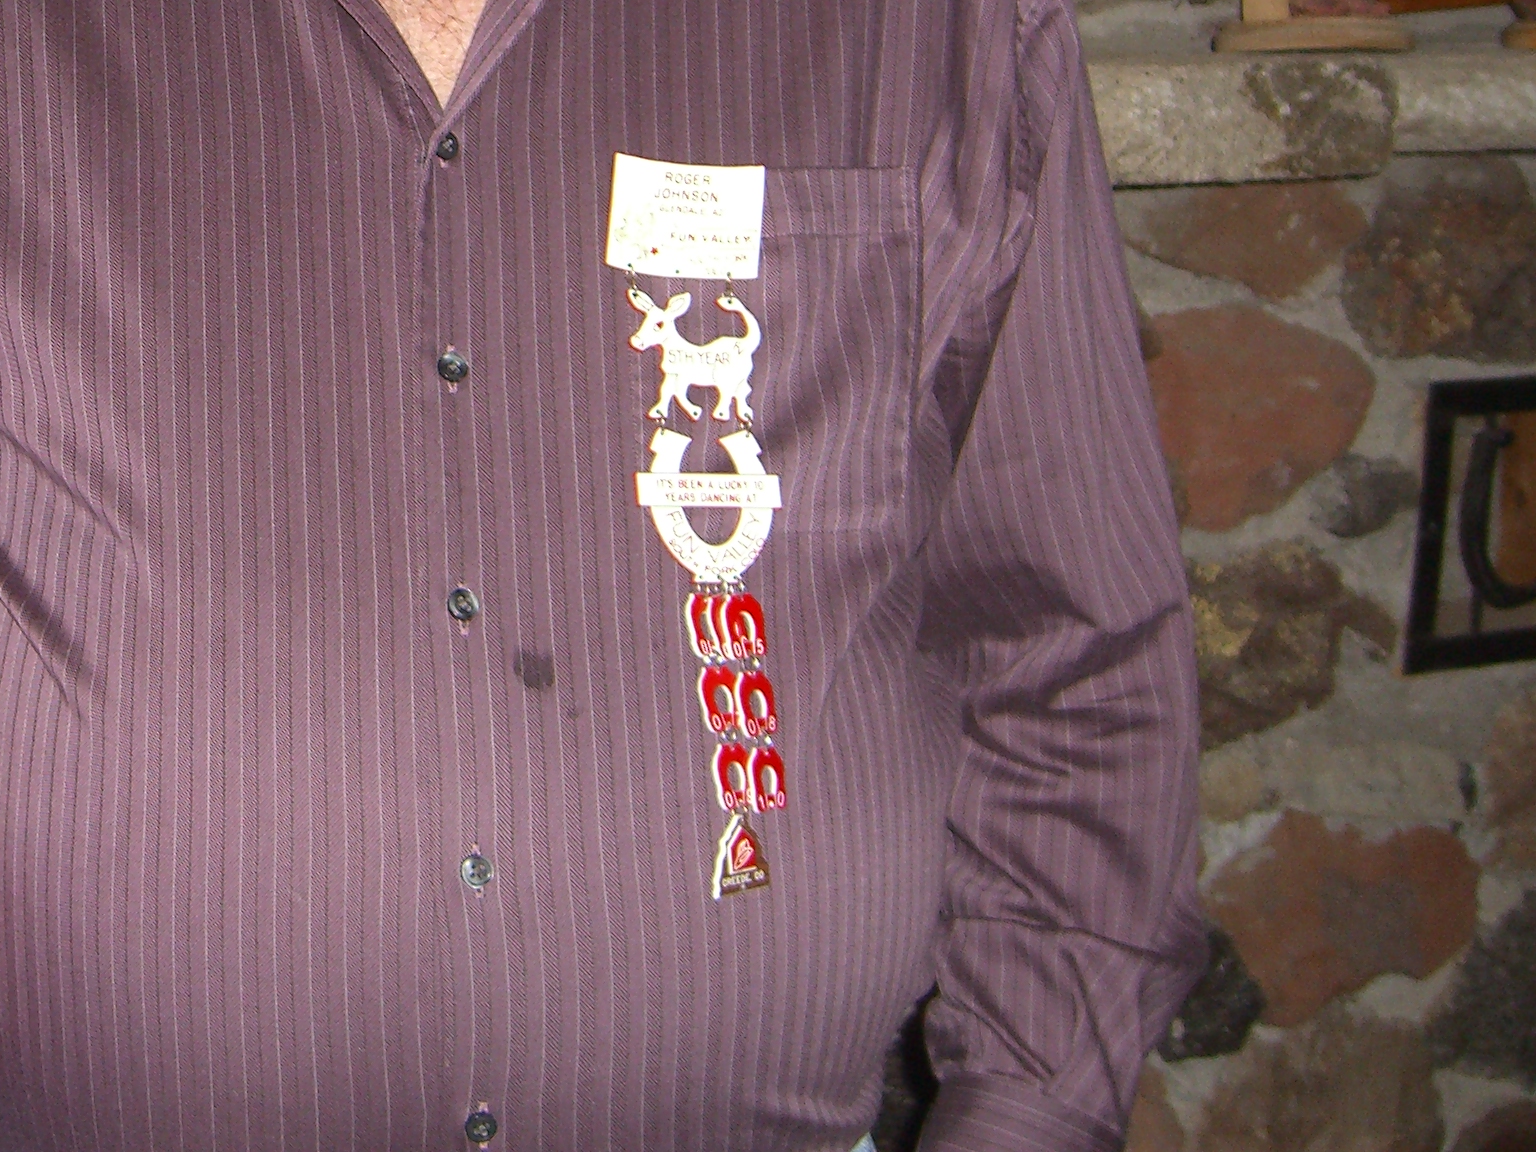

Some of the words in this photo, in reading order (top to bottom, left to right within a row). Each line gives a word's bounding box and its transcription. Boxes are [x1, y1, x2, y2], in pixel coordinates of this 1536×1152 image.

[665, 171, 711, 186] ROGER
[654, 188, 719, 203] JOHNSON
[702, 235, 752, 245] VALLEY
[697, 351, 730, 365] YEAR
[664, 493, 697, 503] YEARS
[700, 493, 741, 503] DANCING
[707, 511, 760, 564] VALLEY
